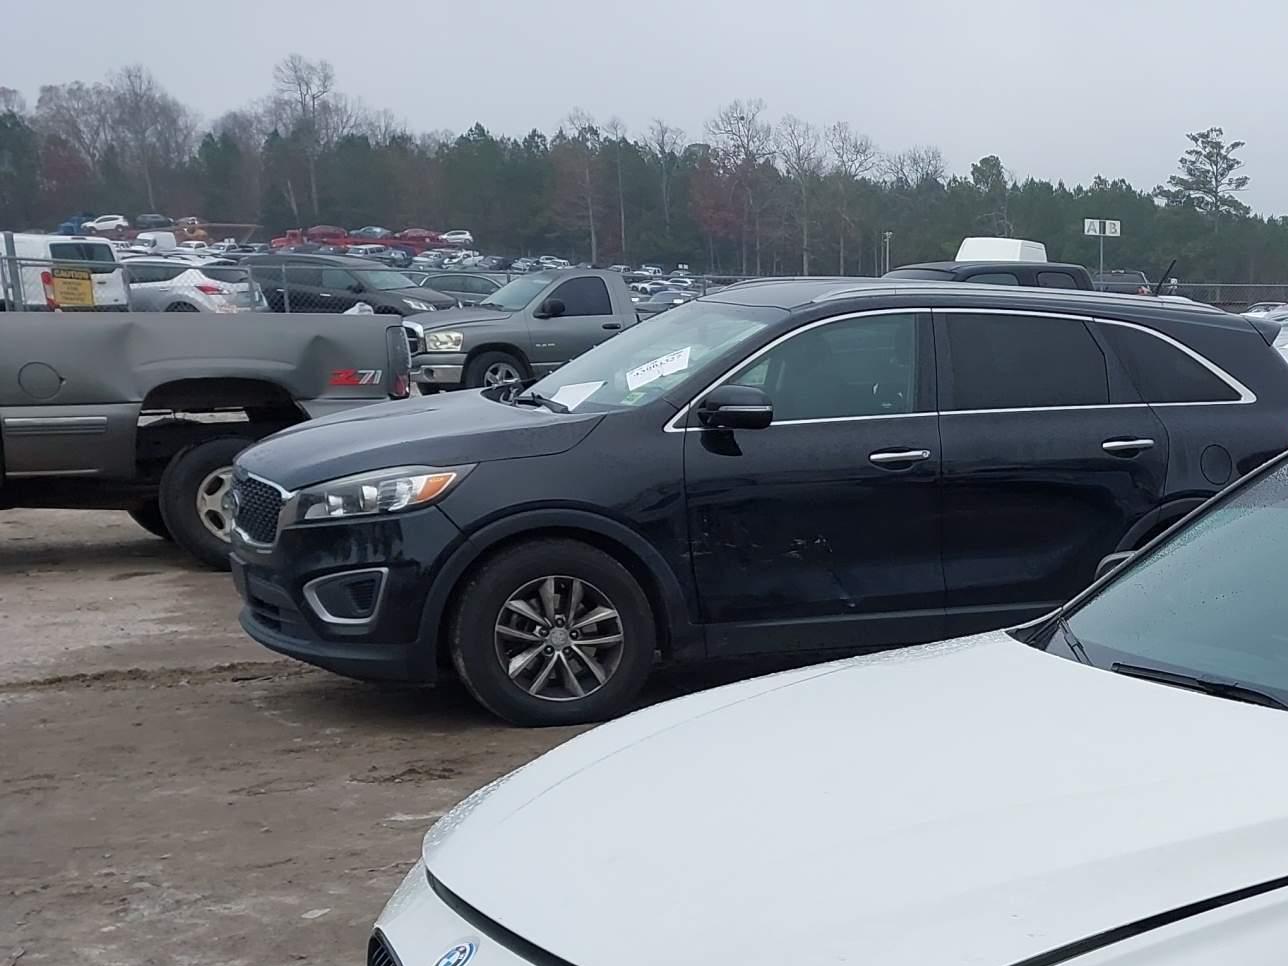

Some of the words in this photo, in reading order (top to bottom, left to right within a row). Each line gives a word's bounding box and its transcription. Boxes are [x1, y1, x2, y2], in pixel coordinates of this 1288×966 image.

[1086, 220, 1098, 234] A
[1107, 221, 1118, 234] B
[329, 368, 383, 385] Z71
